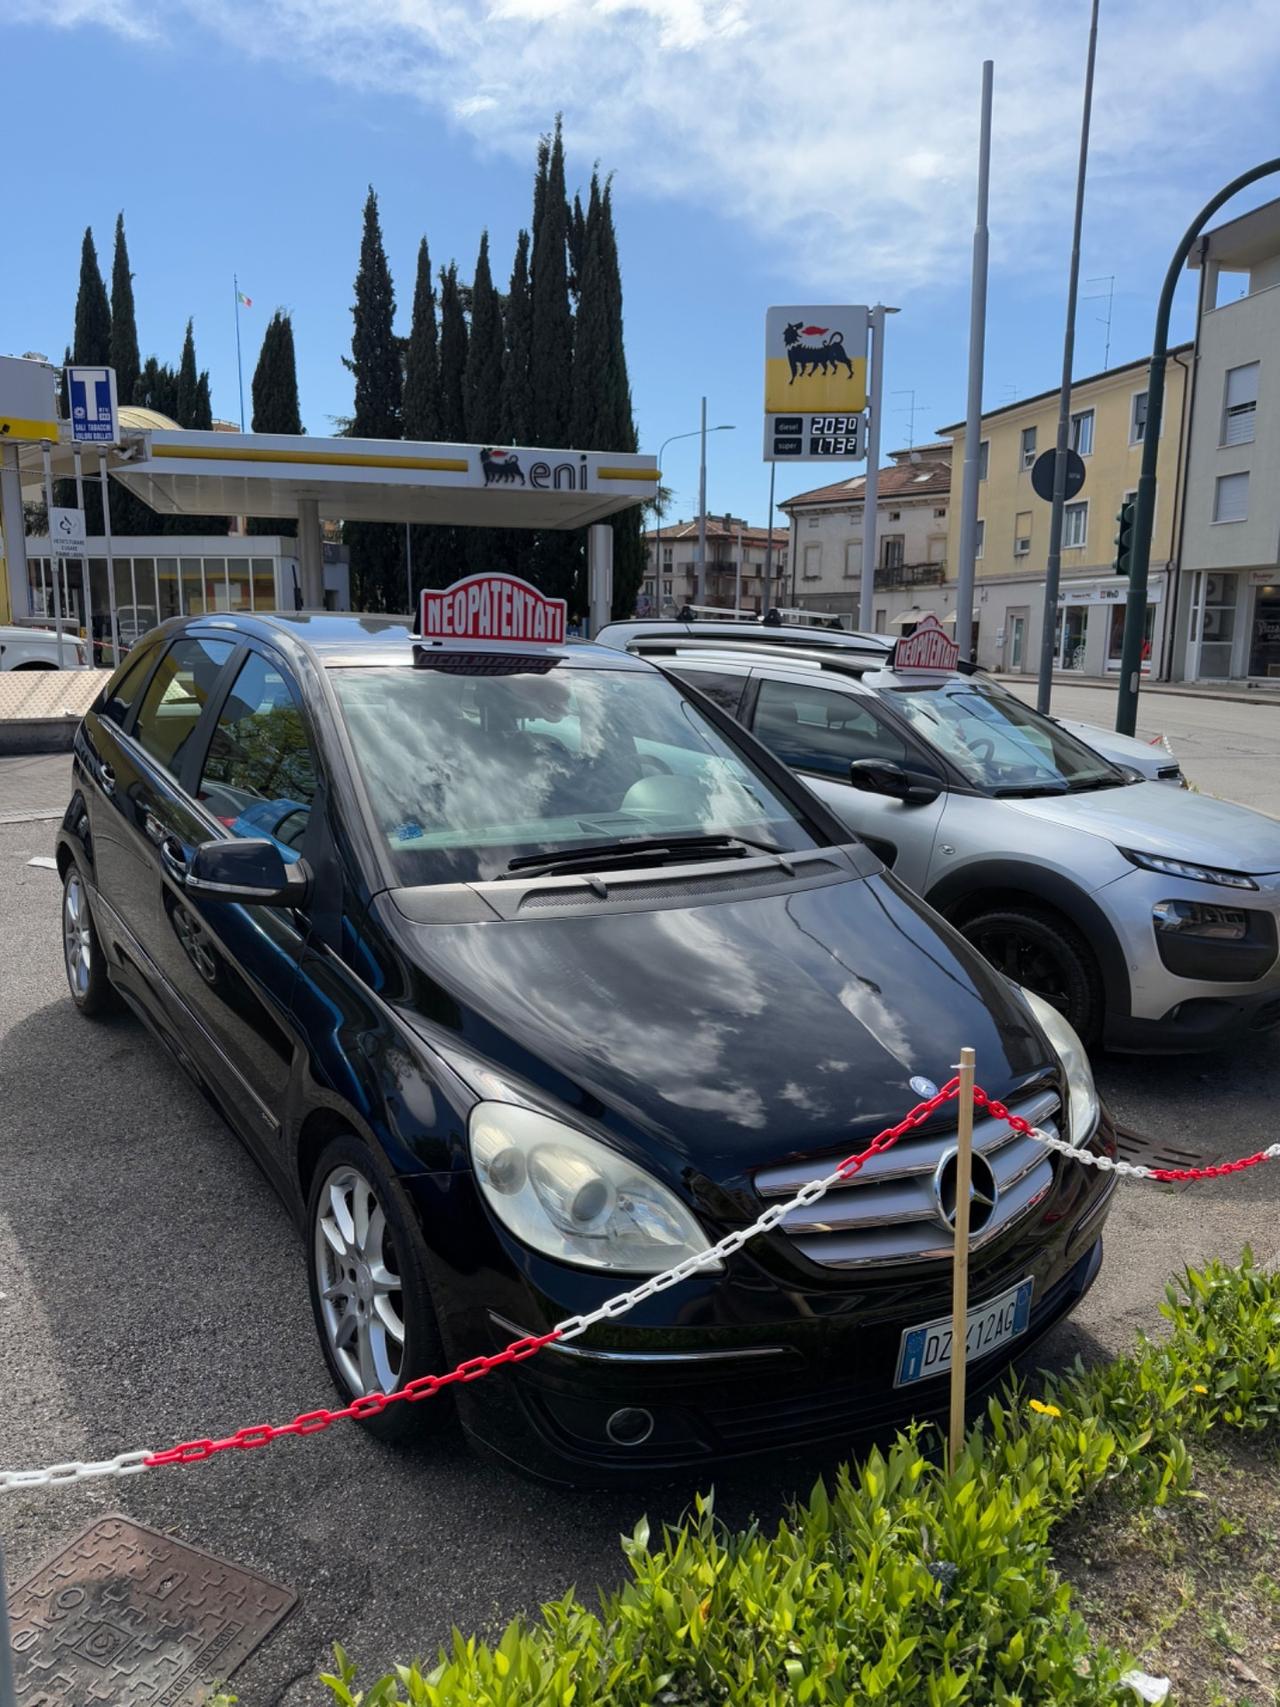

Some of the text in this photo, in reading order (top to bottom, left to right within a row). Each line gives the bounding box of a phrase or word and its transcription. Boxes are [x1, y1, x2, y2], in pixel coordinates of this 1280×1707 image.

[72, 370, 107, 421] T
[529, 454, 588, 490] eni
[428, 580, 561, 640] NEOPATENTATI
